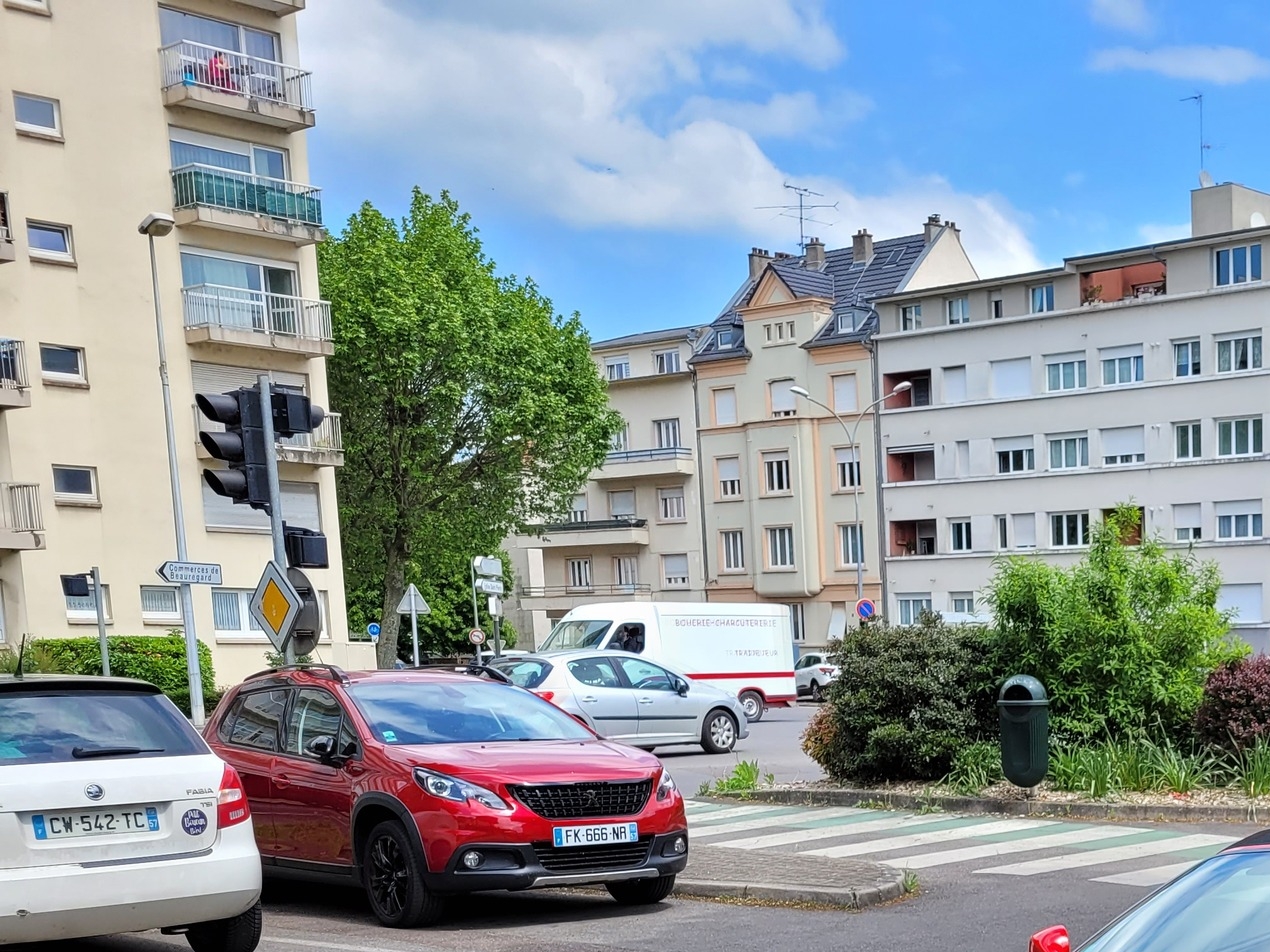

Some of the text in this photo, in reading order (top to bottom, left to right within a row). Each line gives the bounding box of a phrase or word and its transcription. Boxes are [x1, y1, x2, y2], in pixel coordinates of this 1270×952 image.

[169, 564, 208, 574] Commerces
[170, 572, 212, 583] Beauregard
[186, 787, 214, 796] FABIA
[50, 811, 145, 834] CW-542-TC
[148, 819, 158, 828] 57
[565, 826, 627, 844] FK-666-NR
